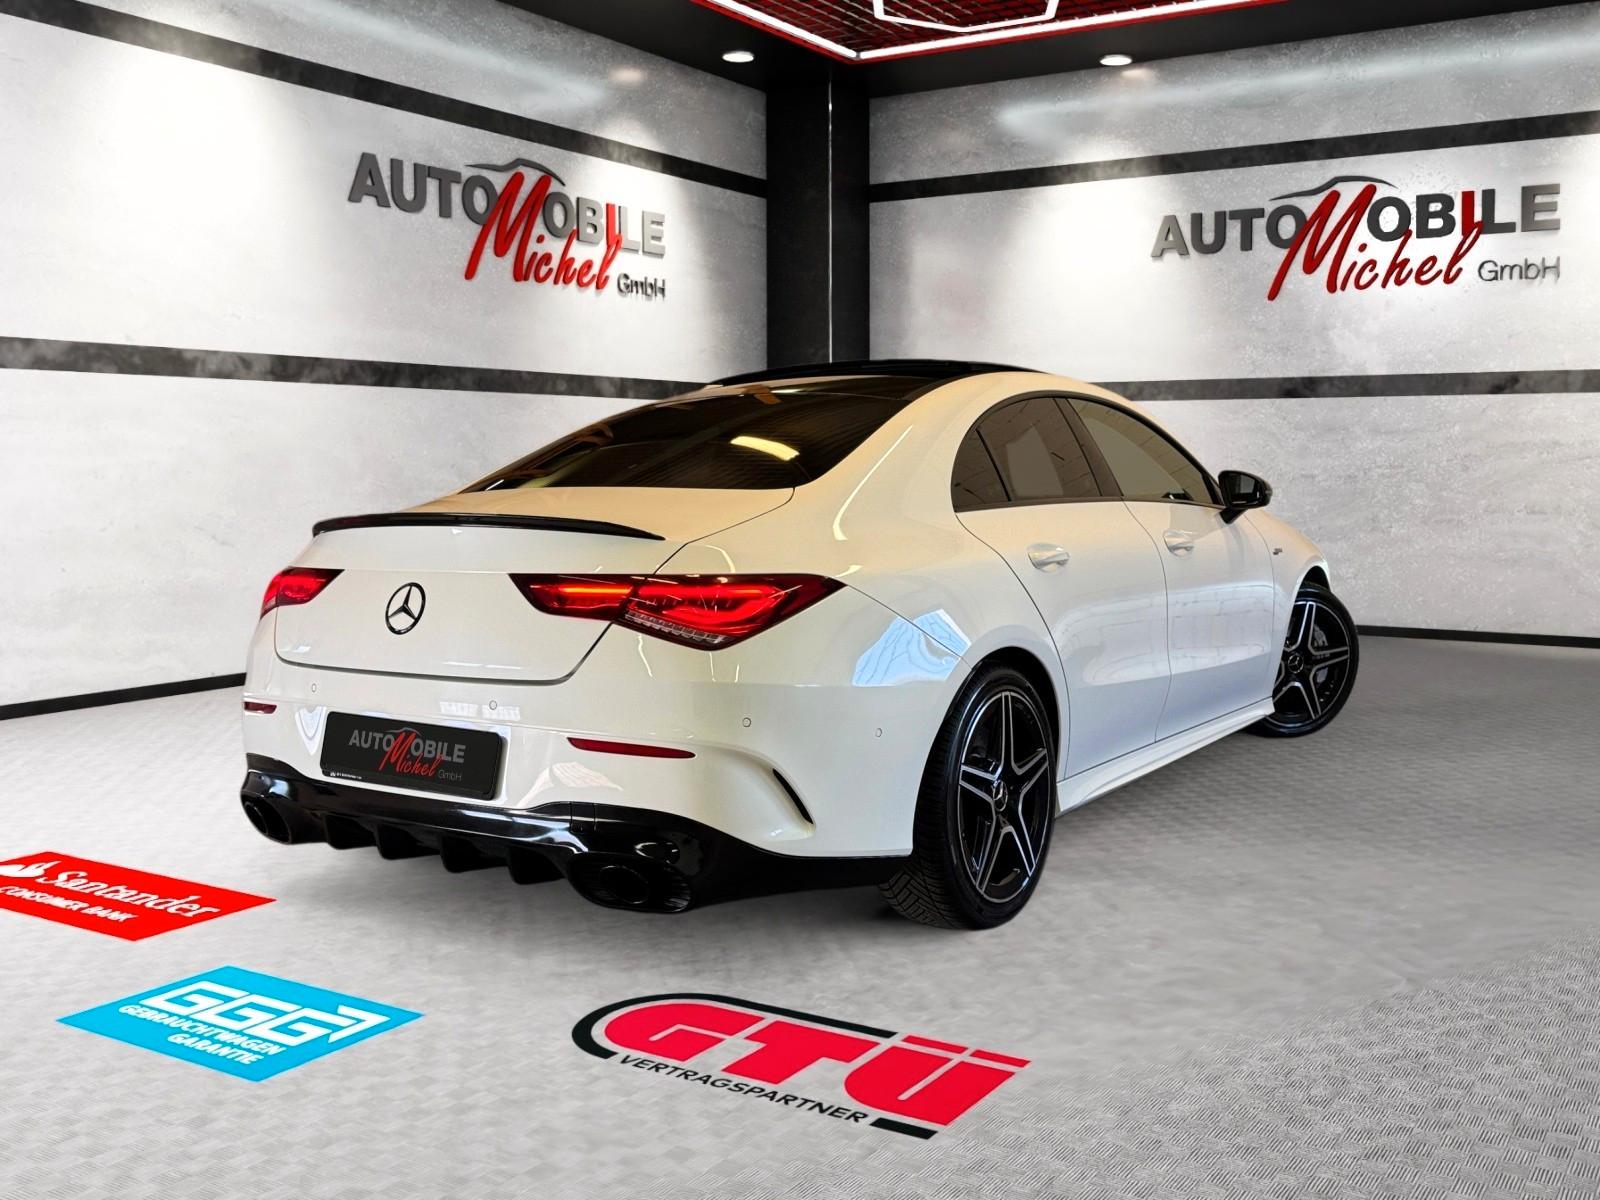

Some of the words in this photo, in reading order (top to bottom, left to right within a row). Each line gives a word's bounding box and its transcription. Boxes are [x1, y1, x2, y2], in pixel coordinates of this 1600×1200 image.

[464, 171, 623, 290] Michel
[617, 272, 666, 299] GmbH
[1267, 184, 1485, 302] Michel
[1477, 255, 1561, 283] GmbH
[378, 731, 445, 777] Michel
[438, 769, 463, 781] GmbH
[0, 885, 89, 912] CONSUMER
[80, 902, 138, 922] BANK
[35, 870, 221, 918] Santander
[118, 1004, 287, 1055] GEBRAUCHTWAGEN
[166, 1032, 264, 1064] GARANTIE
[603, 1003, 1032, 1126] GTÜ
[619, 1054, 869, 1124] VERTRAGSPARTNER
